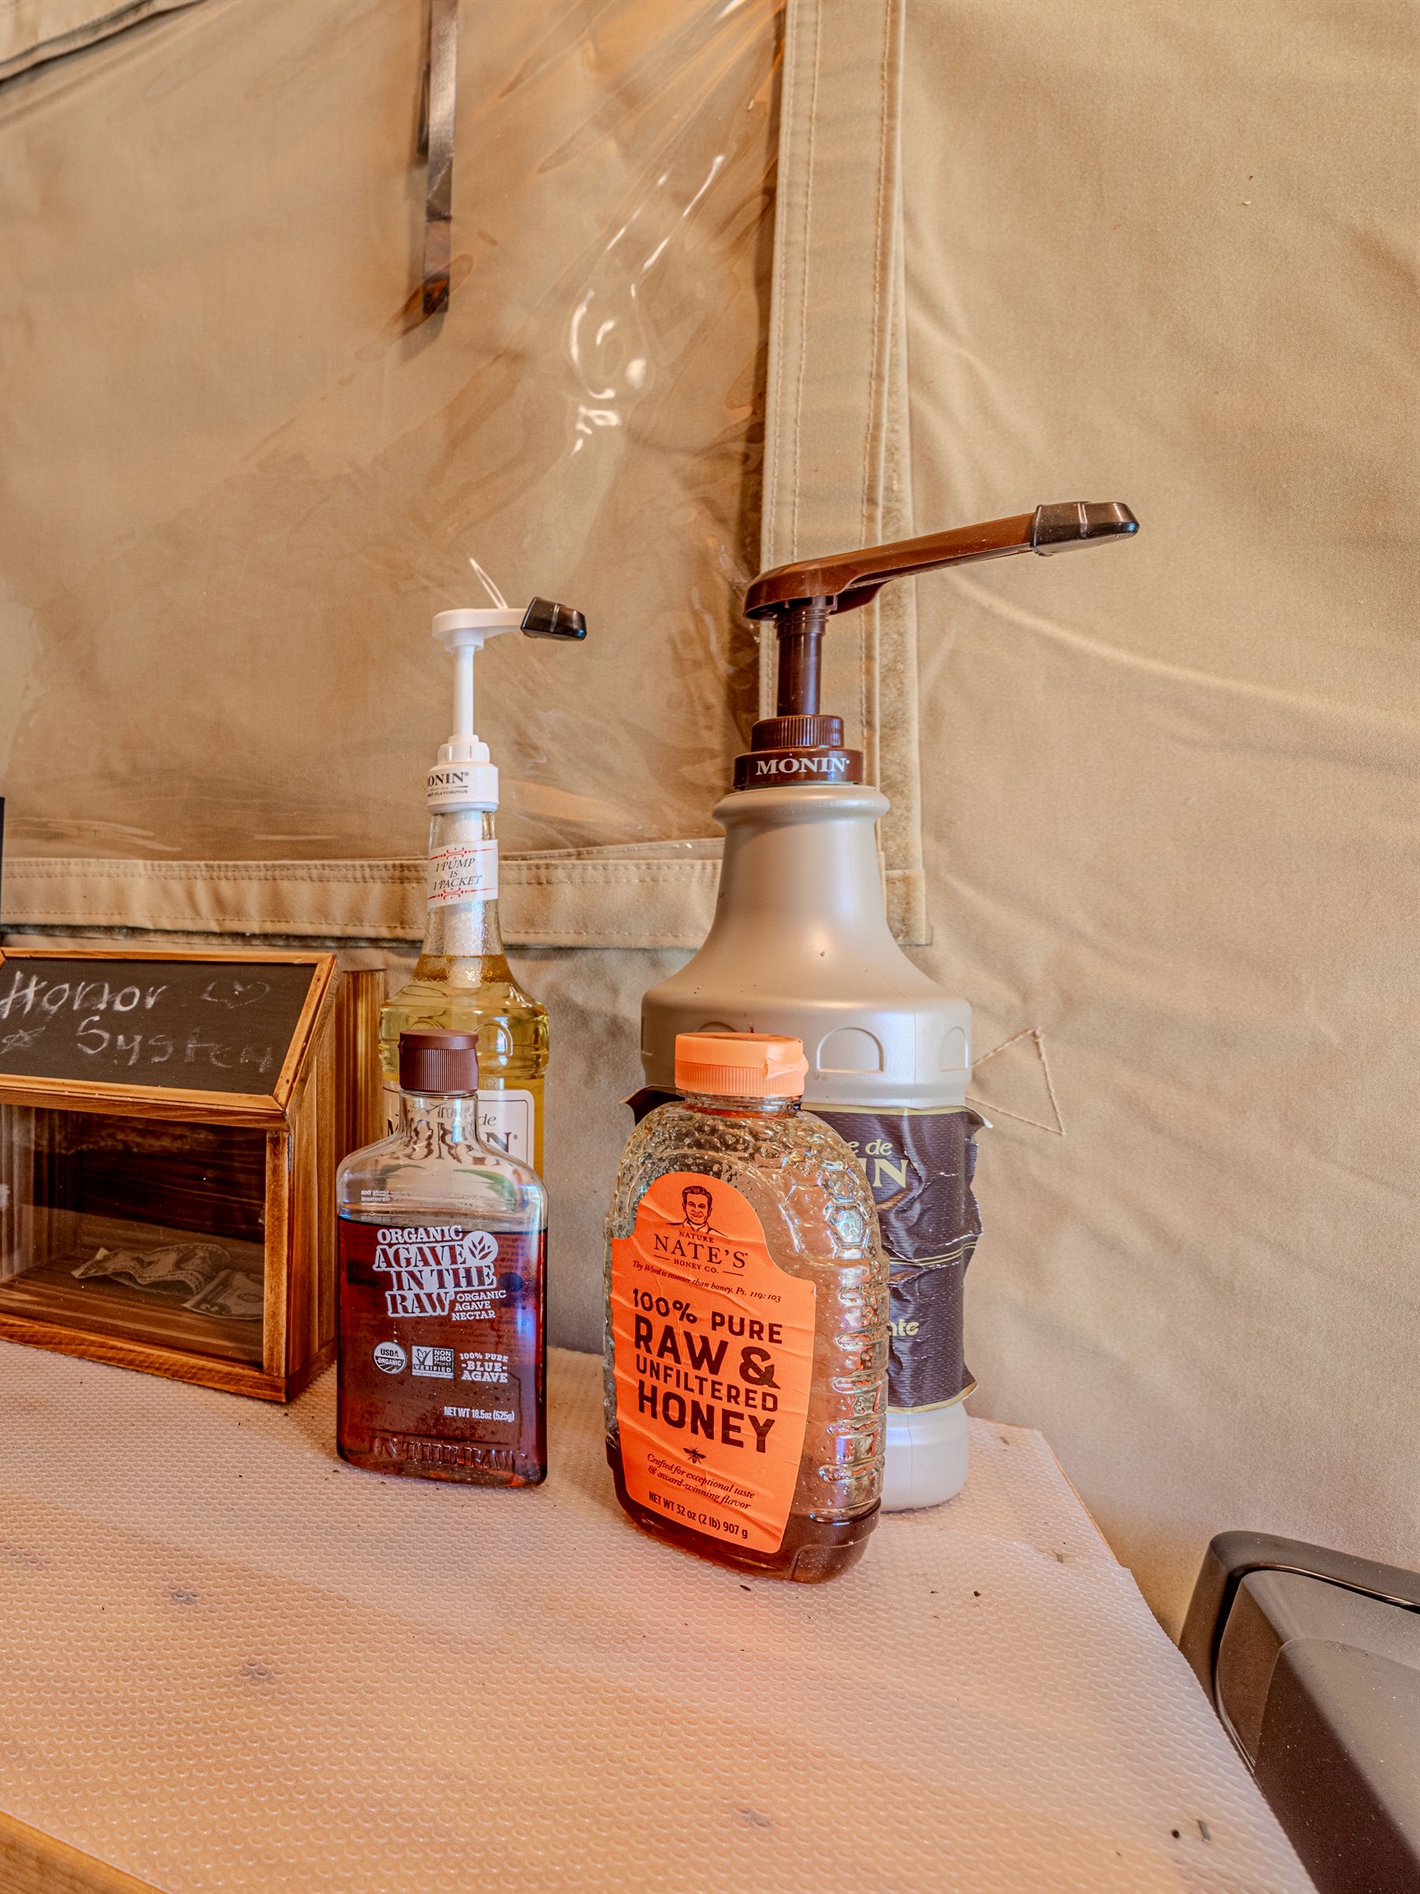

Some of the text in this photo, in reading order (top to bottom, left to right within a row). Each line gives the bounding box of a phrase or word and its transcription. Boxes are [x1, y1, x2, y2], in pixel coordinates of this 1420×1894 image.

[427, 772, 465, 787] ONIN
[441, 858, 476, 871] PUMP
[450, 870, 458, 878] IS
[439, 875, 483, 889] PACKET
[478, 1113, 497, 1127] de
[865, 1139, 893, 1155] de
[377, 1225, 463, 1244] ORGANIC
[679, 1231, 714, 1243] NATURE
[375, 1244, 467, 1269] AGAVE
[654, 1233, 746, 1269] NATE'S
[674, 1258, 719, 1274] HONEY CO.
[393, 1265, 497, 1291] IN THE
[632, 1260, 643, 1271] Thy
[644, 1264, 661, 1276] Word
[692, 1278, 710, 1288] than
[736, 1286, 747, 1296] Ps.
[767, 1293, 782, 1303] 103
[388, 1291, 450, 1315] RAW
[457, 1290, 507, 1302] ORGANIC
[454, 1301, 491, 1311] AGAVE
[451, 1310, 496, 1321] NECTAR
[632, 1288, 783, 1345] 100% PURE
[380, 1348, 399, 1357] USDA
[485, 1353, 508, 1363] PURE
[634, 1313, 781, 1389] RAW &
[377, 1357, 402, 1366] ORGANIC
[414, 1364, 452, 1373] VERIFIED
[461, 1371, 508, 1383] AGAVE
[636, 1354, 778, 1412] UNFILTERED
[444, 1406, 458, 1417] NET
[458, 1407, 470, 1418] WT
[638, 1379, 776, 1454] HONEY
[647, 1453, 755, 1499] Crafted for exceptional taste
[648, 1465, 751, 1510] & award-winning flavor
[649, 1491, 748, 1539] NET WT 32 oz (2 lb) 907 g
